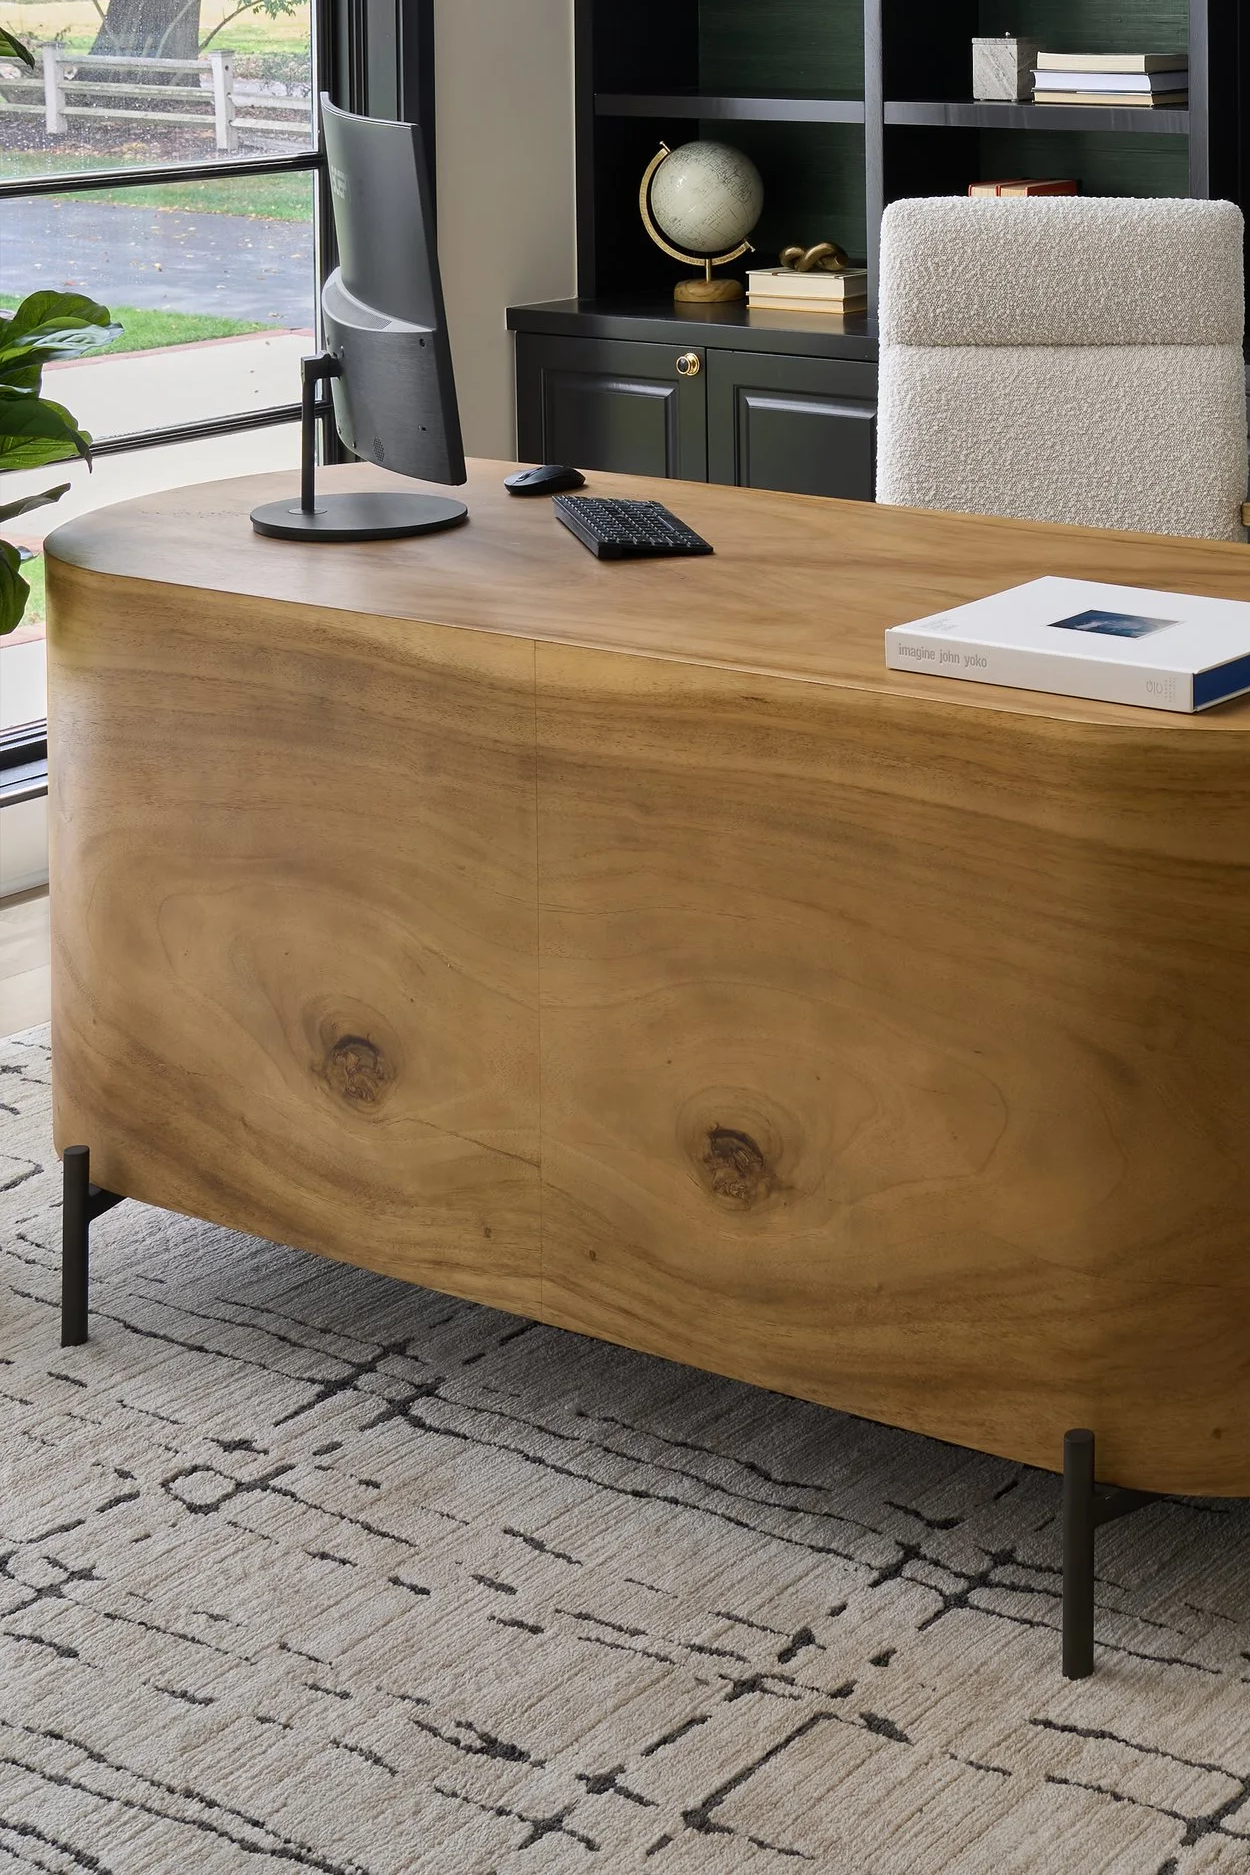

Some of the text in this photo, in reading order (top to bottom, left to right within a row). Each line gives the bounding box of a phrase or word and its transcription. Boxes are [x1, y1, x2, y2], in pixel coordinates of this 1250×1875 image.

[898, 643, 988, 668] imagine john yoko
